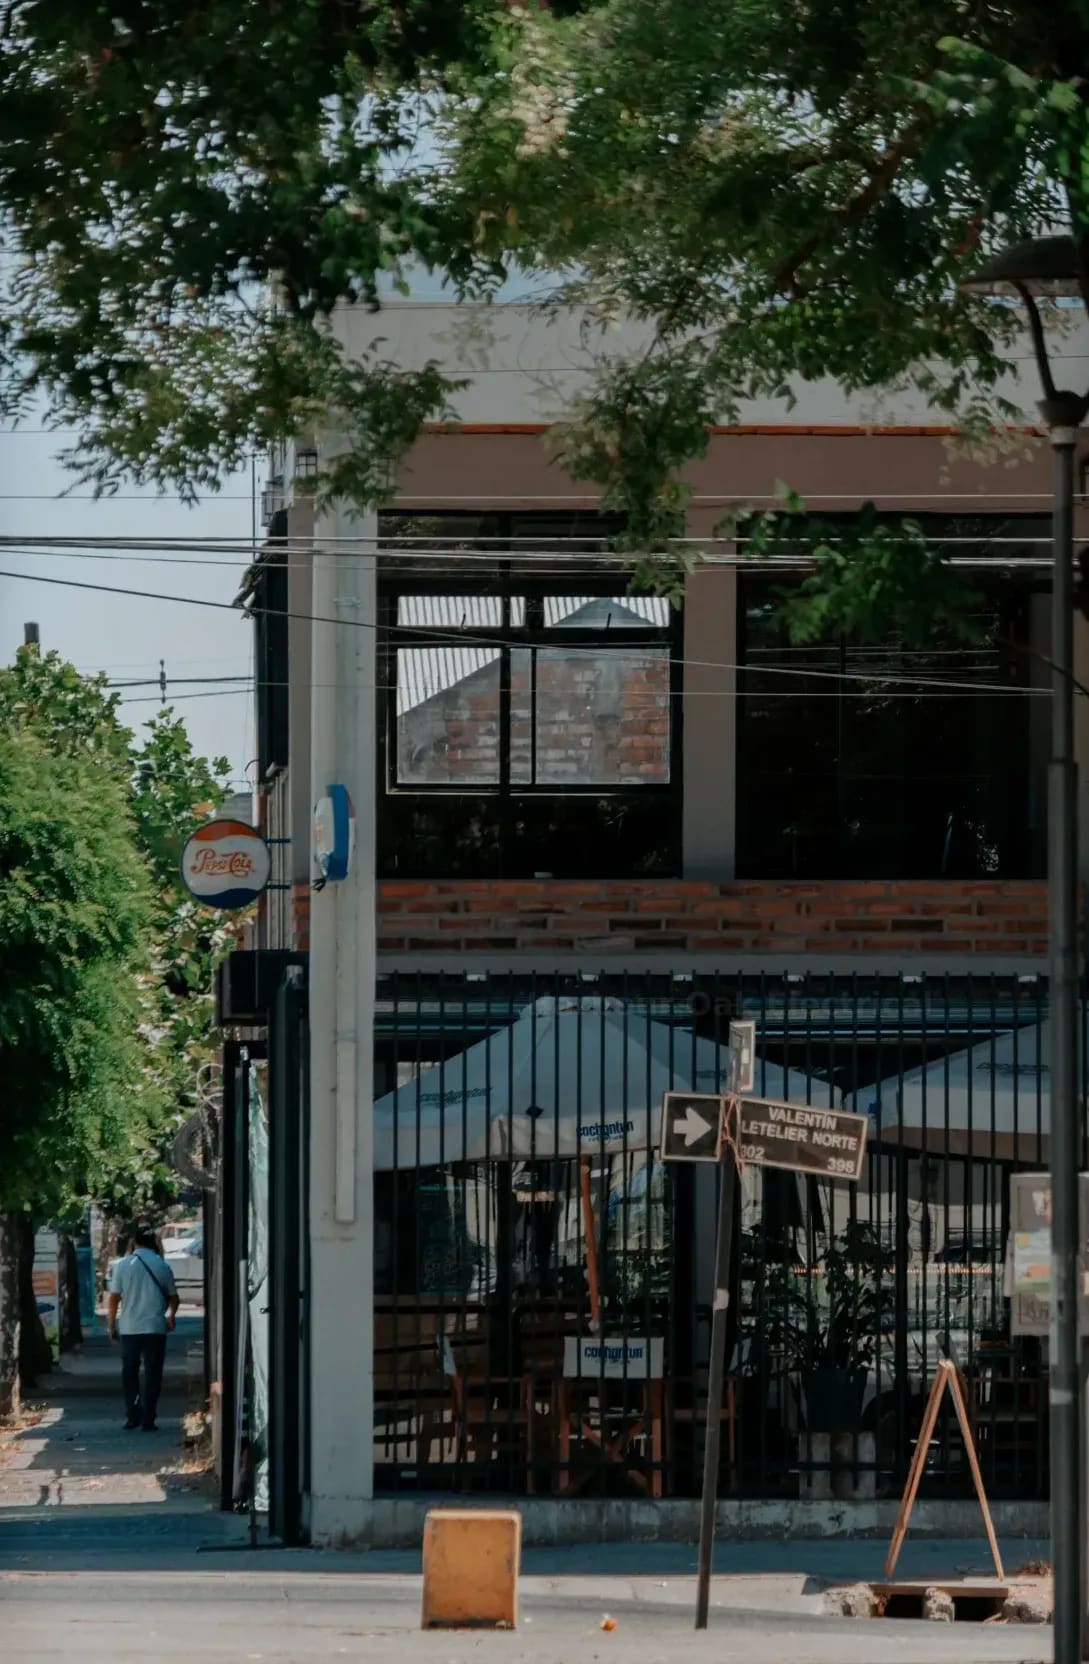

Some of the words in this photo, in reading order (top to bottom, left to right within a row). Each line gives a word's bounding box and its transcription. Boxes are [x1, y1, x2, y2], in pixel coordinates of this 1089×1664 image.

[741, 1120, 809, 1143] LETELIER
[812, 1131, 858, 1151] NORTE
[741, 1144, 766, 1160] 302
[827, 1157, 855, 1174] 398
